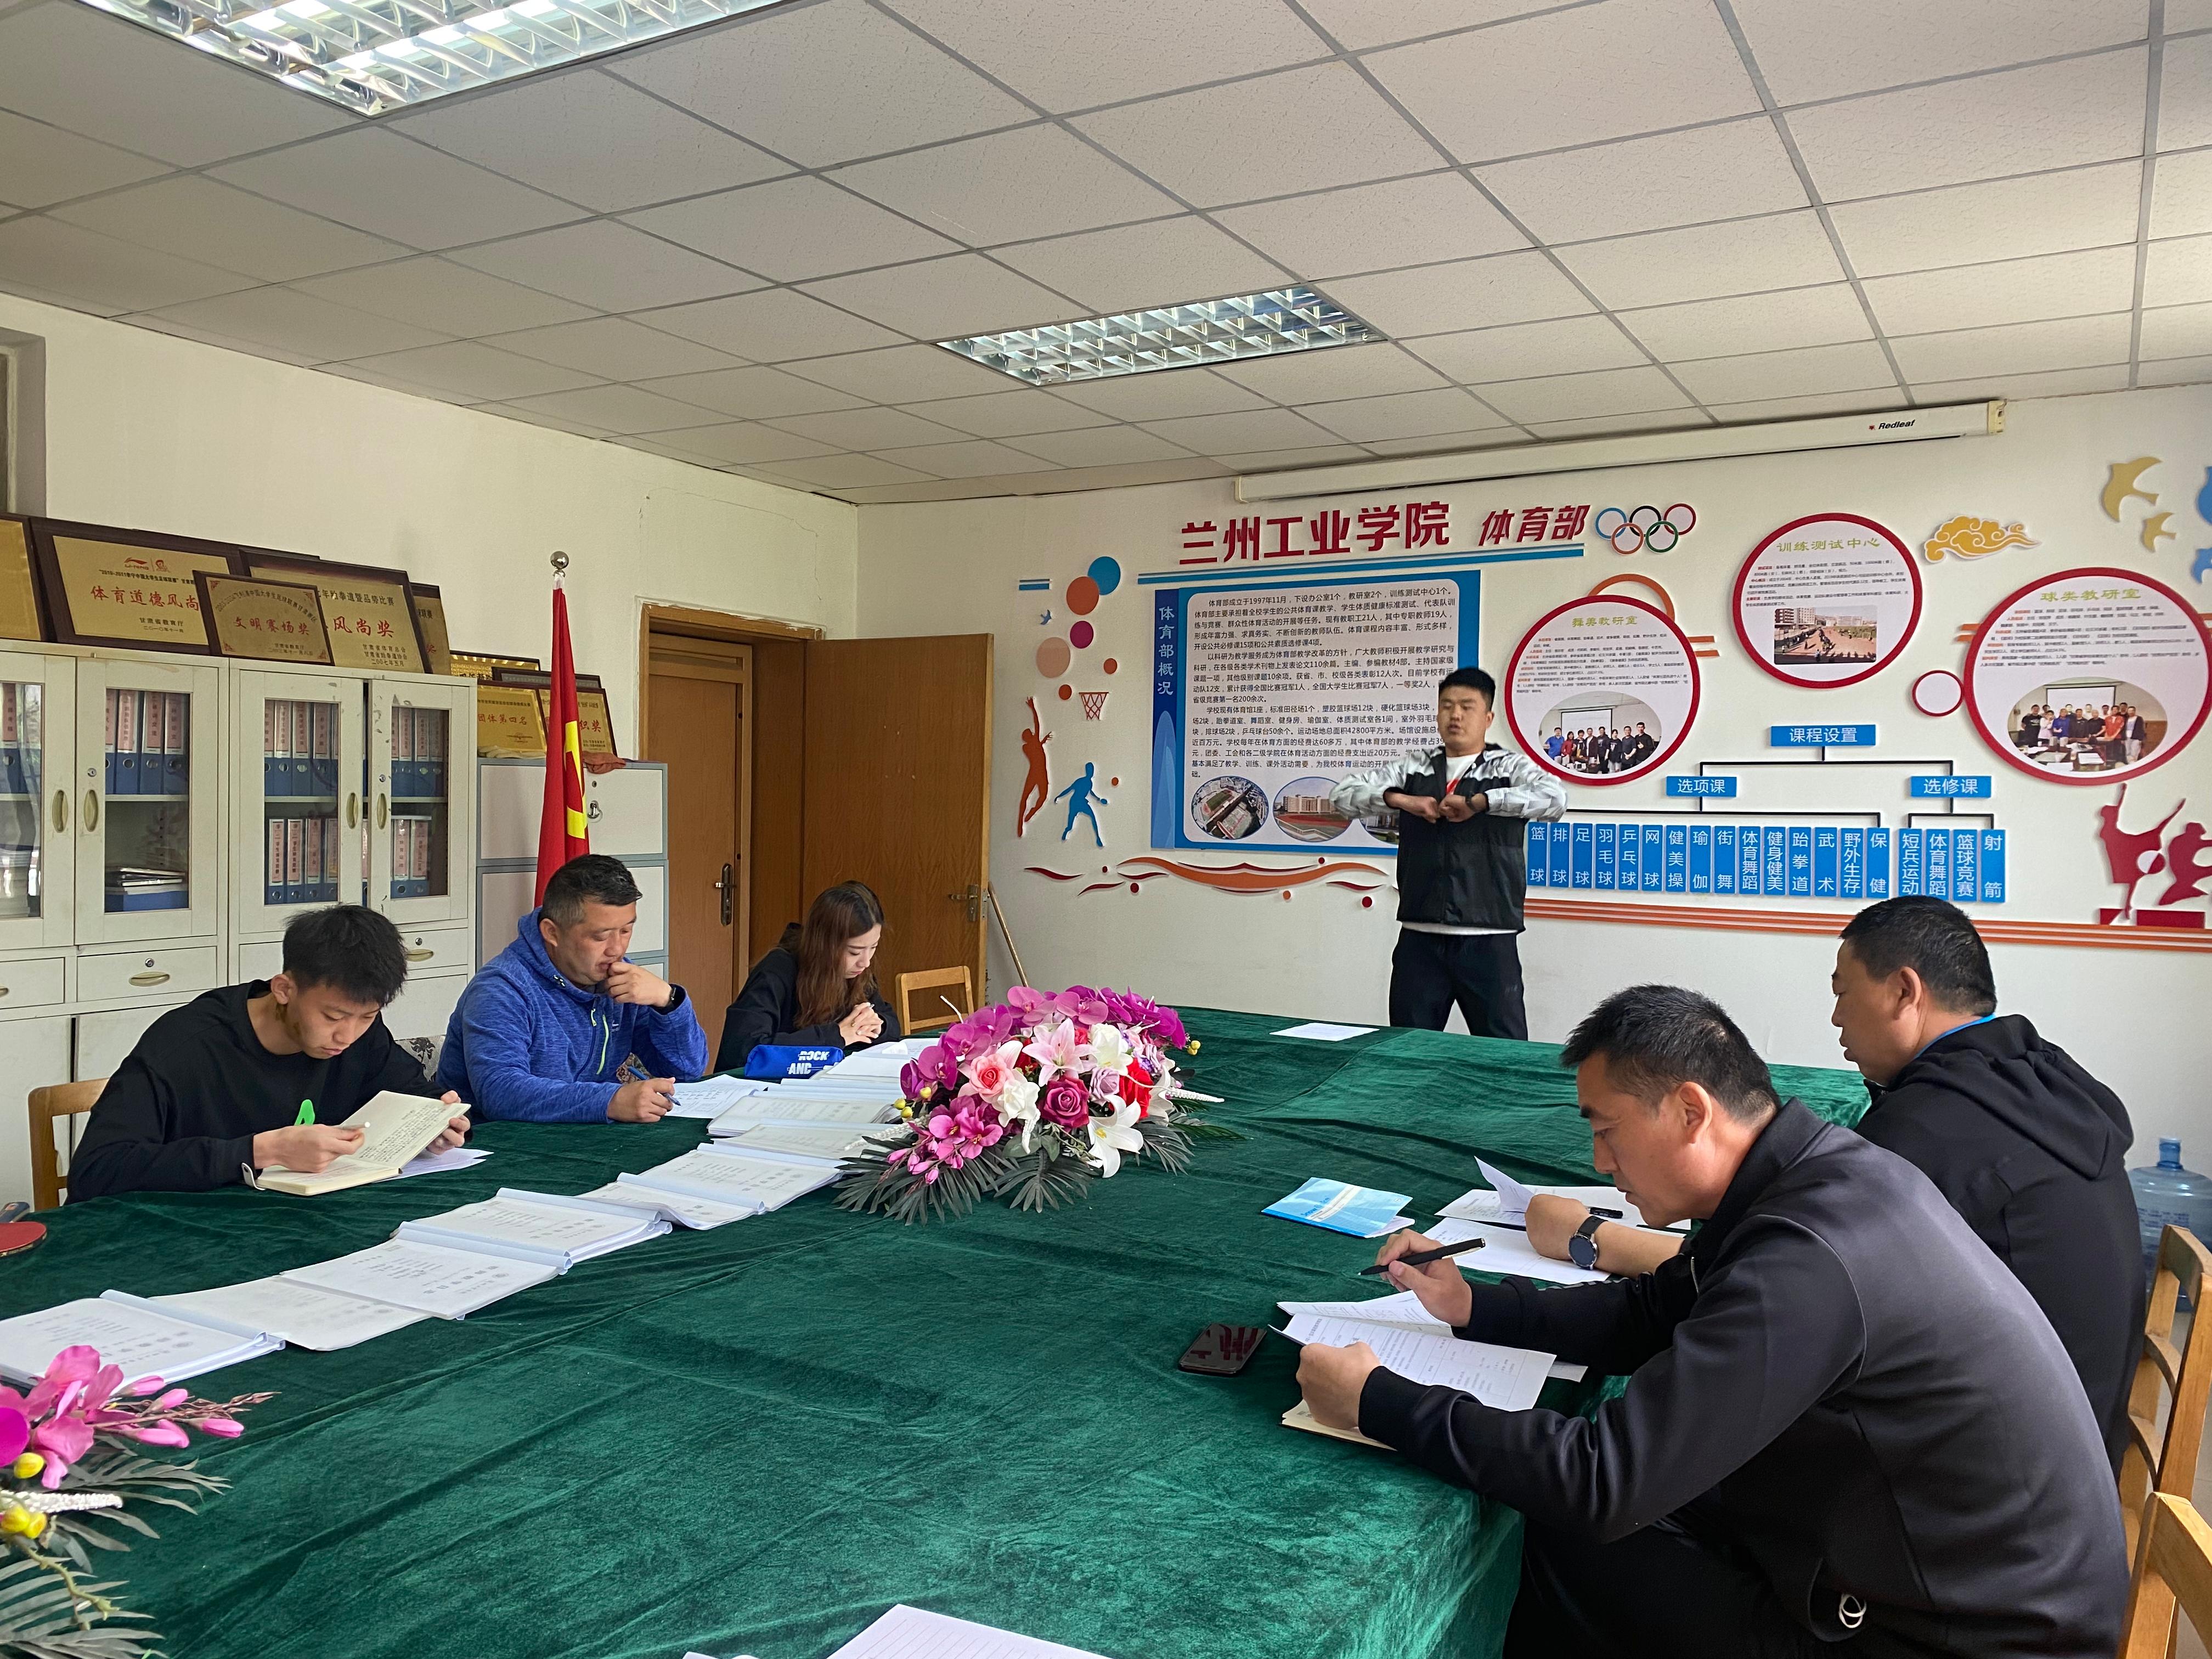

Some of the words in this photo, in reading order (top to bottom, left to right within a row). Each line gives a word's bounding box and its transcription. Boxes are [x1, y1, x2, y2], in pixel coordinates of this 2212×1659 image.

[1878, 420, 1915, 430] Redleaf
[1179, 501, 1450, 565] 兰州工业学院
[1478, 505, 1590, 546] 体育部
[1776, 538, 1880, 552] 训练测试中心
[91, 585, 199, 611] 体育道德风尚
[2040, 589, 2142, 602] 球类教研室
[234, 616, 309, 636] 文明赛场奖
[333, 616, 394, 638] 风尚奖
[1158, 606, 1175, 696] 体育部概况
[1790, 727, 1858, 743] 课程设置
[1677, 778, 1726, 794] 选项课
[1923, 778, 1978, 795] 选修课
[1530, 826, 1545, 882] 篮球
[1553, 827, 1567, 884] 排球
[1575, 828, 1590, 885] 足球
[1598, 829, 1613, 885] 羽毛球
[1621, 830, 1637, 886] 乒乓球
[1644, 830, 1660, 887] 网球
[1668, 830, 1684, 888] 健美操
[1692, 831, 1708, 889] 瑜伽
[1717, 831, 1733, 889] 街舞
[1742, 831, 1758, 890] 体育舞蹈
[1767, 831, 1783, 891] 健身健美
[1792, 833, 1809, 892] 跆拳道
[1818, 833, 1835, 893] 武术
[1843, 833, 1861, 893] 野外生存
[1870, 833, 1887, 894] 保健
[1901, 833, 1920, 895] 短兵运动
[1929, 834, 1948, 896] 体育舞蹈
[1957, 834, 1975, 897] 篮球竞赛
[1984, 835, 2003, 898] 射箭
[788, 1063, 812, 1075] AND
[798, 1051, 830, 1061] ROCK
